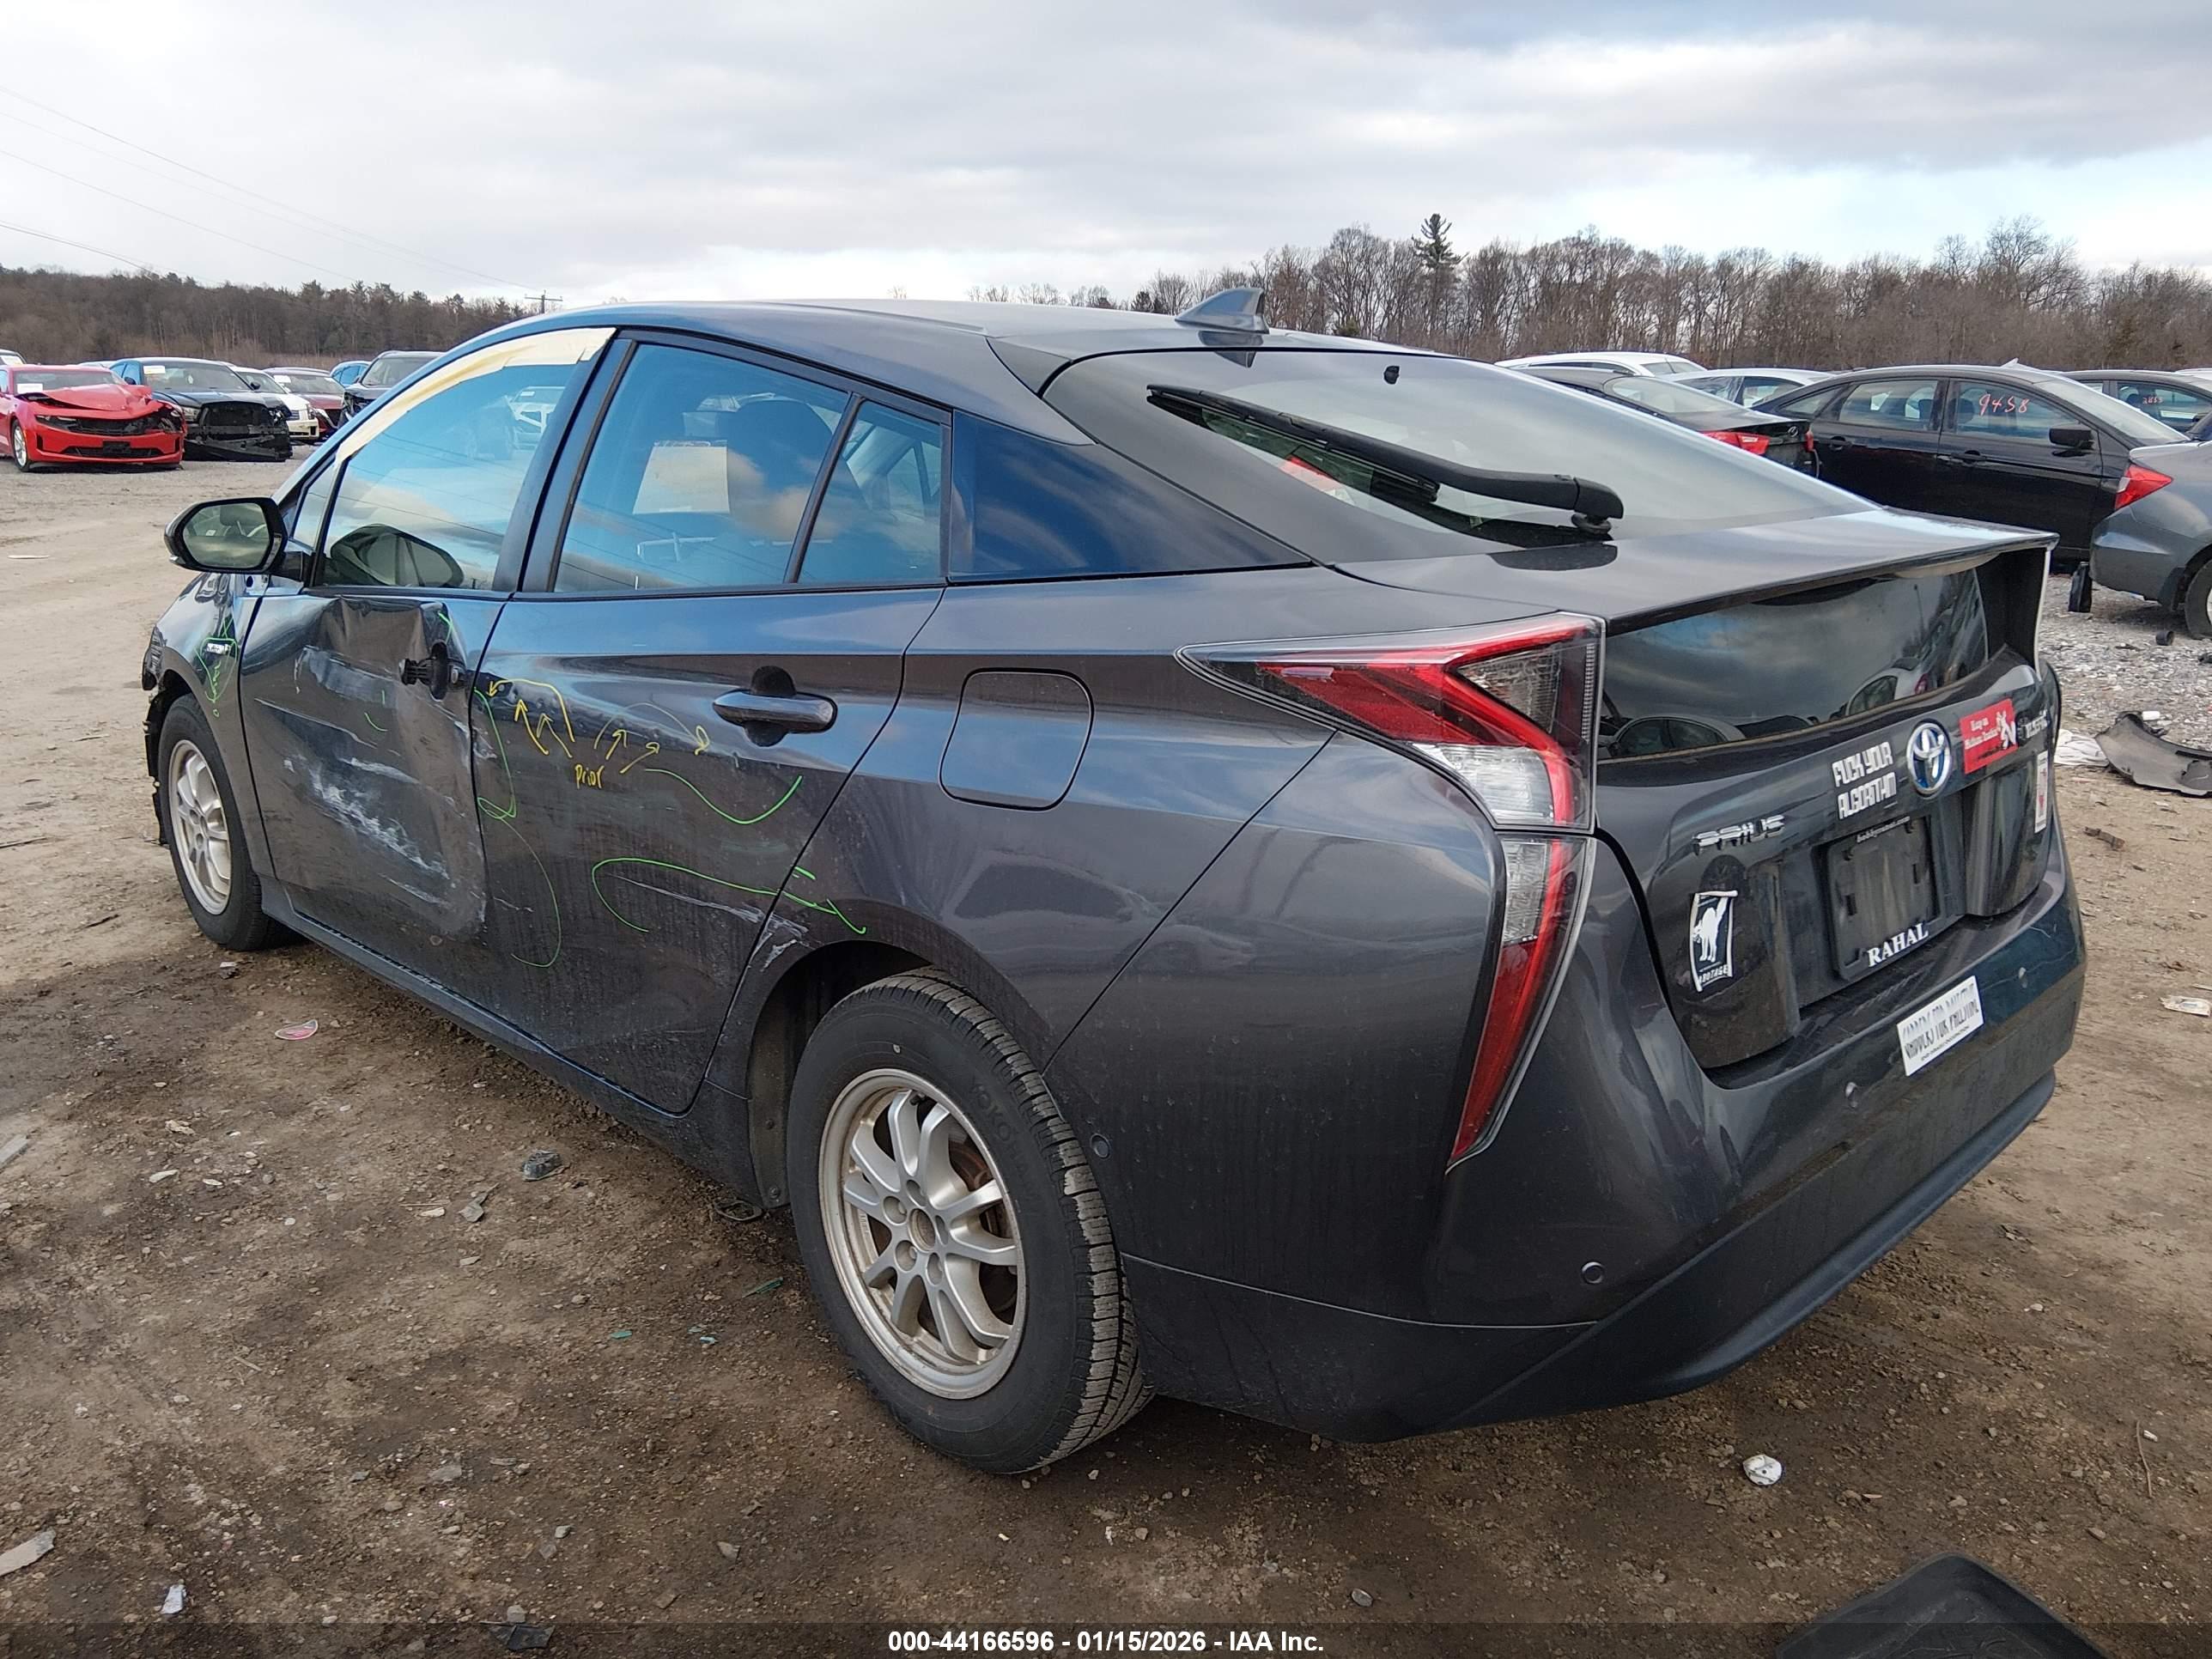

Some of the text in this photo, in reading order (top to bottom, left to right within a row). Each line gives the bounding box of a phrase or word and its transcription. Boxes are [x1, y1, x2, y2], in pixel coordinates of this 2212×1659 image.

[1978, 393, 2030, 416] 9458
[1832, 741, 1893, 787] FUCK YOUR
[1838, 771, 1897, 820] ALGORITHM
[1867, 922, 1929, 968] RAHAL
